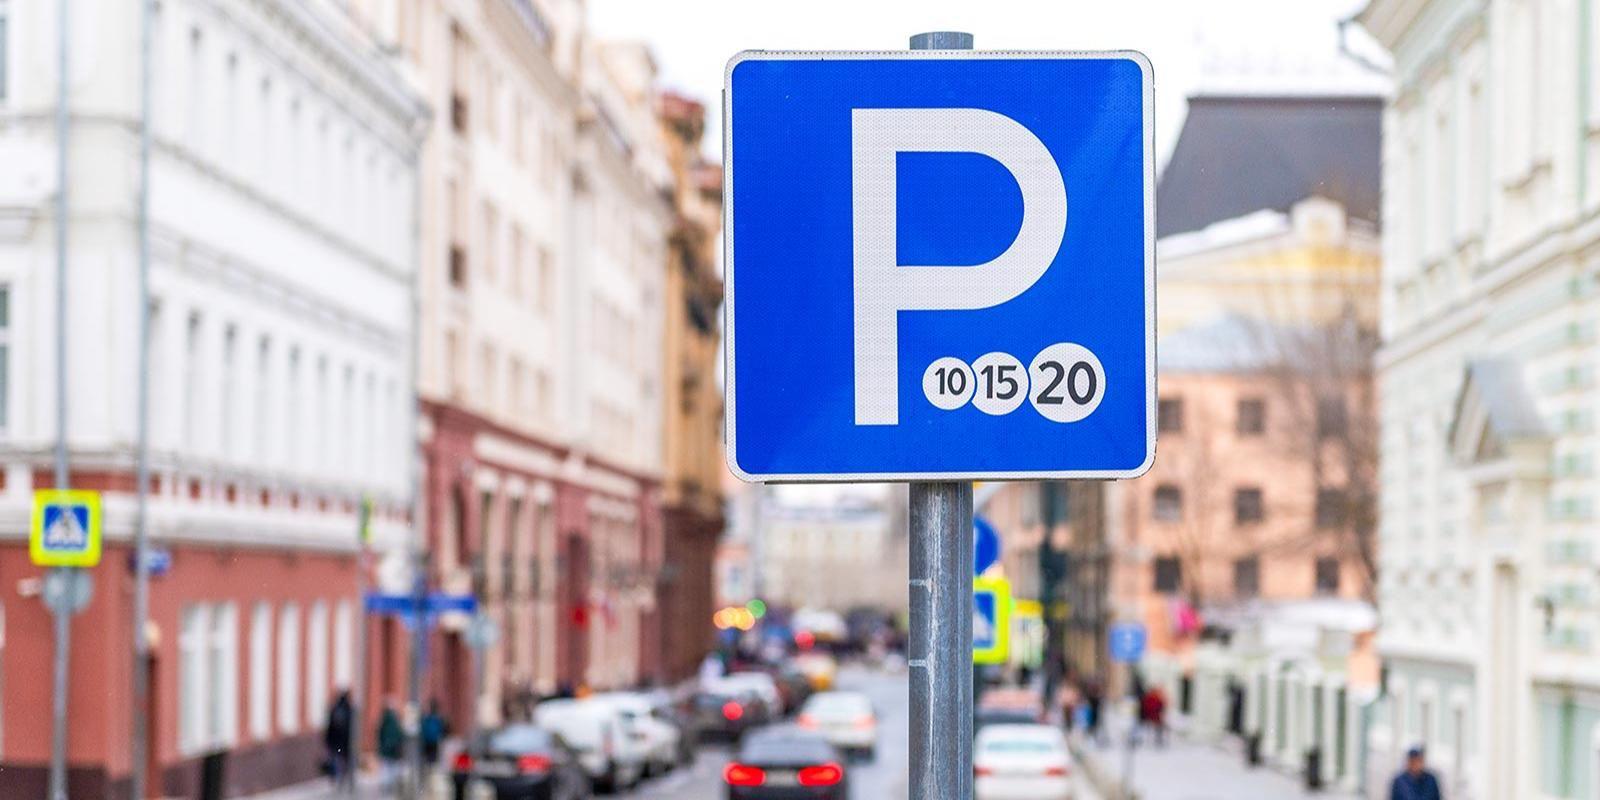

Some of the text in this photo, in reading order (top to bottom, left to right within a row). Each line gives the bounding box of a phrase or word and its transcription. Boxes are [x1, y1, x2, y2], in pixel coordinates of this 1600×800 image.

[852, 108, 1067, 425] P
[935, 360, 1097, 405] 10 15 20
